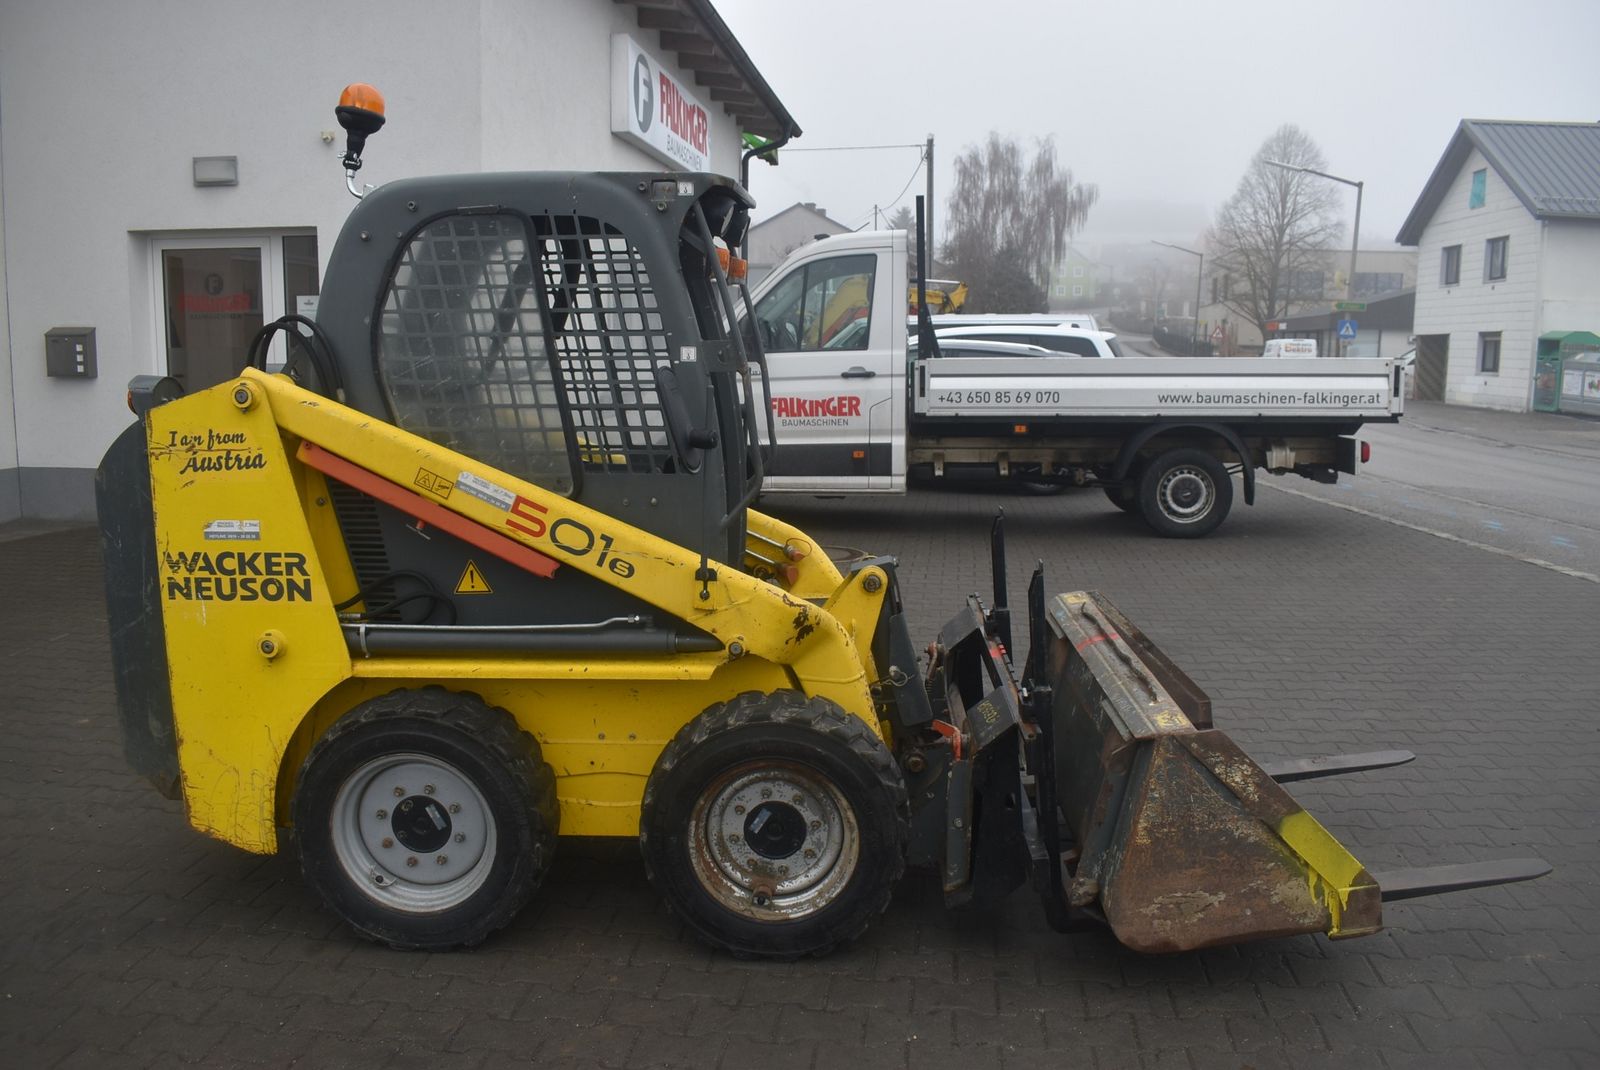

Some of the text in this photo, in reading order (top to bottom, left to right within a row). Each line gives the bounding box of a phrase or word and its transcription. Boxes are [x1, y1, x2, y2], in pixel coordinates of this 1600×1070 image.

[658, 70, 708, 157] FALKINGER
[938, 391, 1060, 404] +43 650 85 69 070
[1158, 392, 1381, 407] www.baumaschinen-falkinger.at
[781, 418, 849, 427] BAUMASCHINEN
[168, 431, 178, 448] I
[207, 429, 246, 449] from
[179, 450, 267, 475] Austria
[162, 551, 310, 577] WACKER
[167, 577, 312, 602] NEUSON
